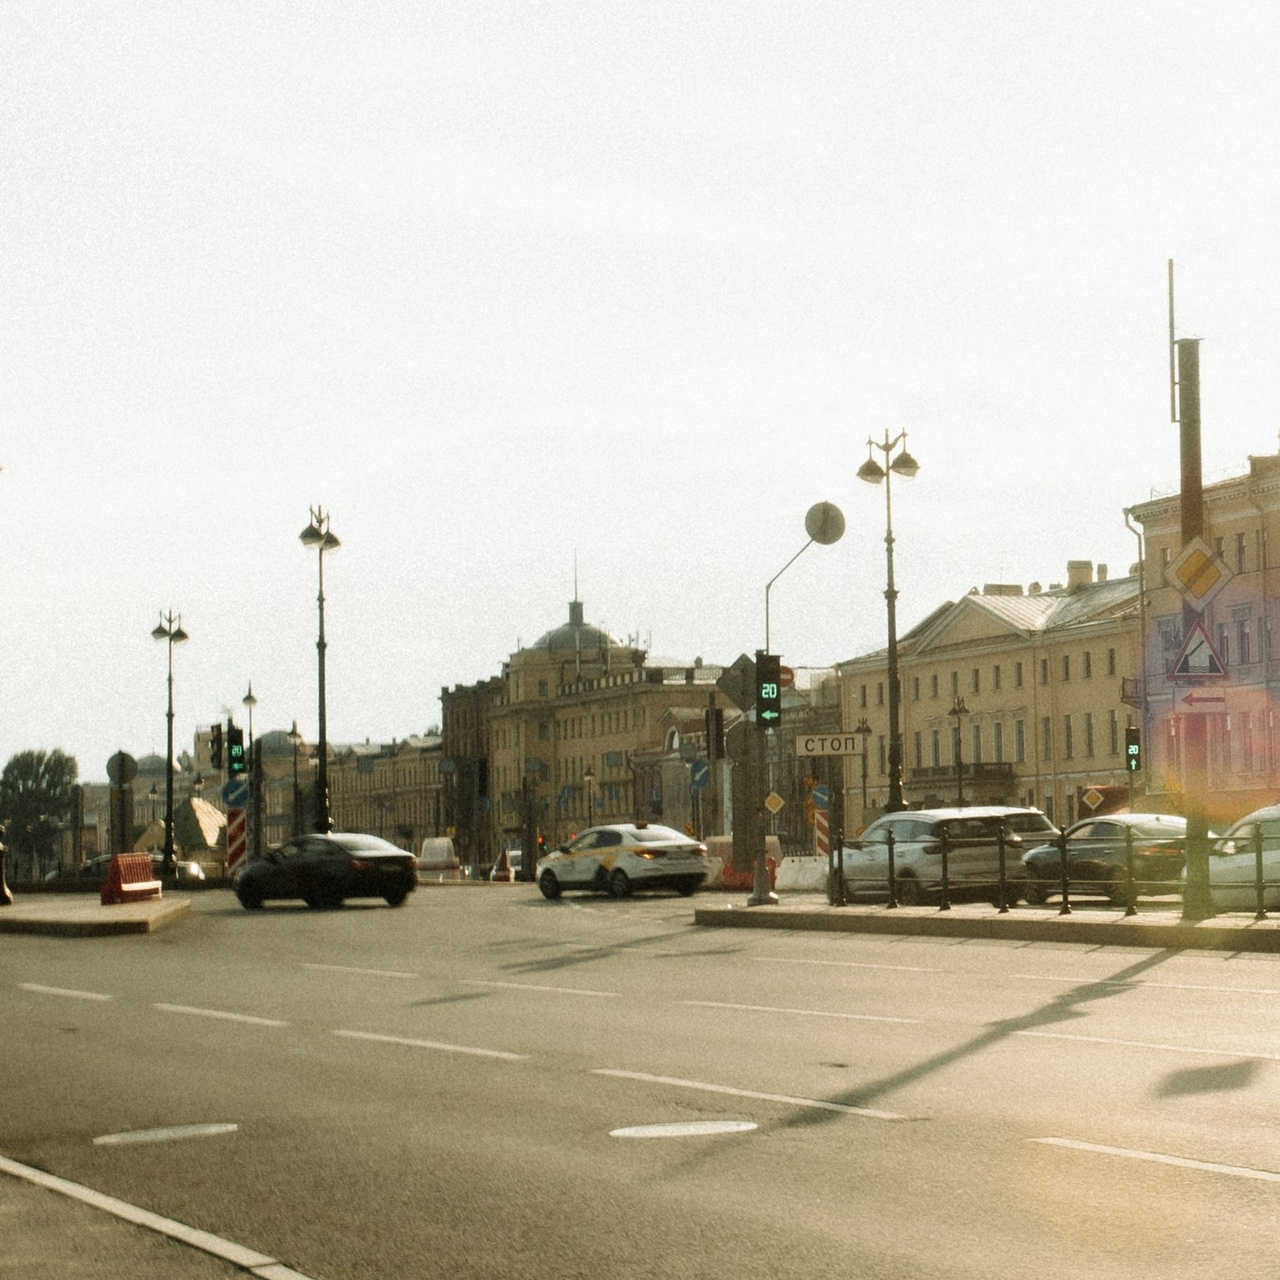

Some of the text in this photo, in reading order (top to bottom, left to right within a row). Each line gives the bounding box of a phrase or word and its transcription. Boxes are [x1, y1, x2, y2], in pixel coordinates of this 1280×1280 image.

[762, 683, 777, 699] 20
[804, 737, 855, 752] СТОП
[1128, 744, 1139, 755] 20
